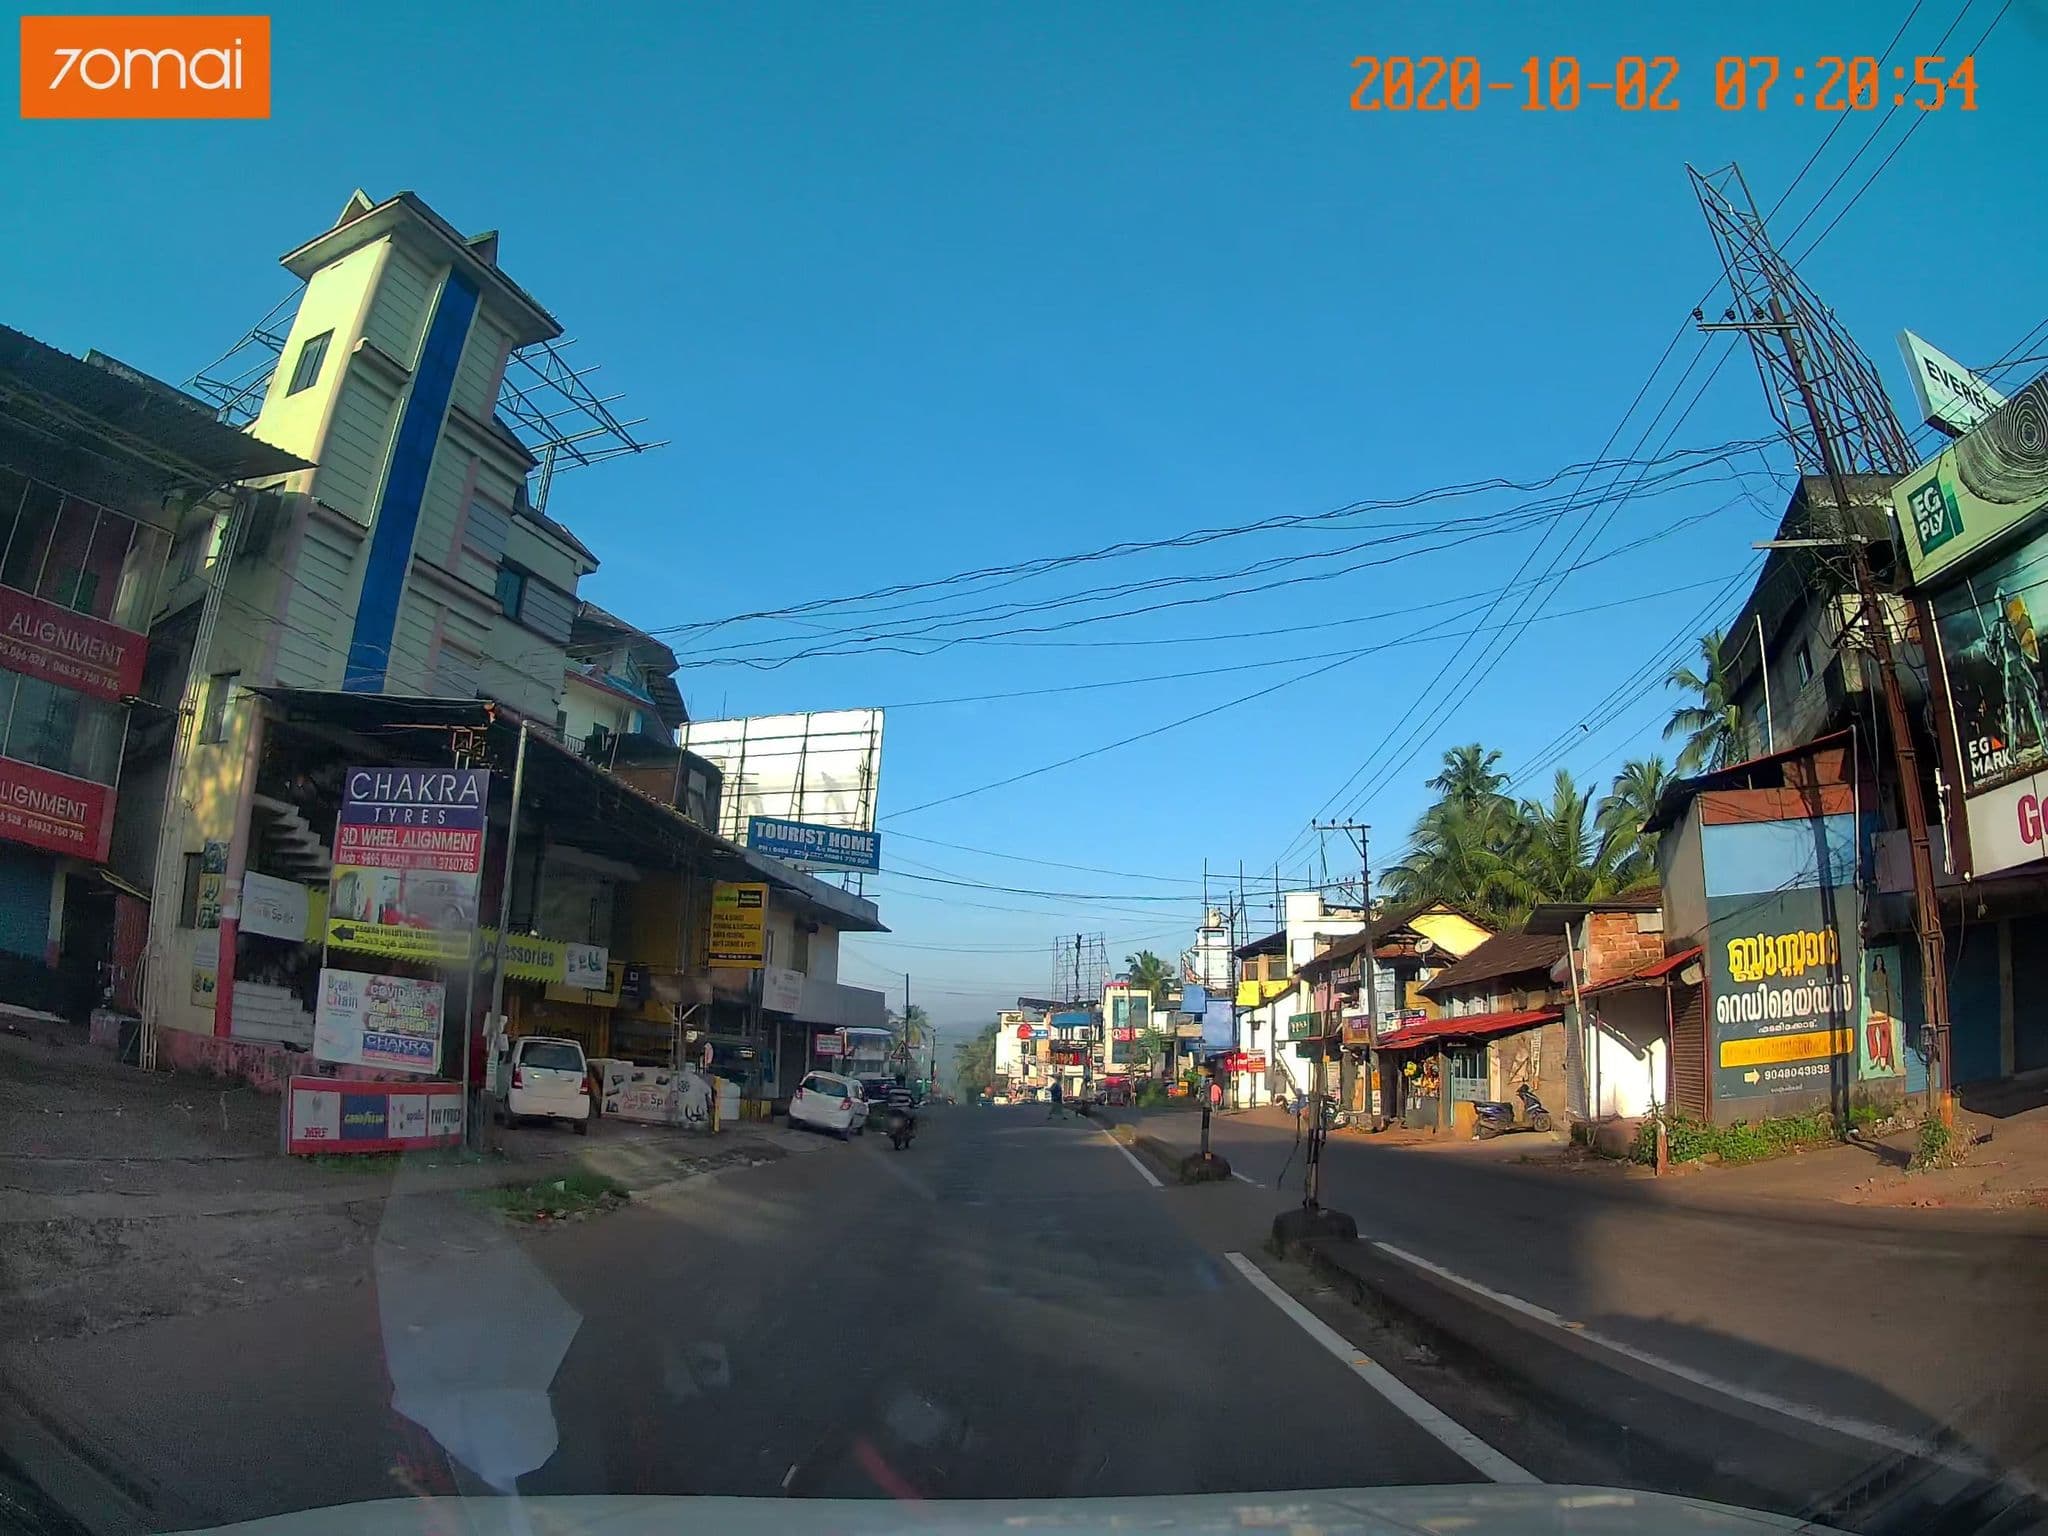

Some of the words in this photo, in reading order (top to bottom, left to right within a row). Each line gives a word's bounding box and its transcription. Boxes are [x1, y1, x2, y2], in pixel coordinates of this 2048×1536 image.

[1913, 486, 1942, 519] EG
[1919, 508, 1945, 542] PLY
[8, 612, 125, 666] ALIGNMENT
[1968, 736, 1990, 759] EG
[1971, 747, 2013, 778] MARK
[350, 772, 480, 803] CHAKRA
[374, 807, 447, 825] TYRES
[2017, 793, 2048, 845] G
[341, 827, 358, 846] 3D
[361, 828, 400, 847] WHEEL
[402, 829, 477, 852] ALIGNMENT
[755, 821, 826, 846] TOURIST
[828, 831, 875, 852] HOME
[366, 1035, 431, 1052] CHAKRA
[1764, 1063, 1831, 1081] 9048043832
